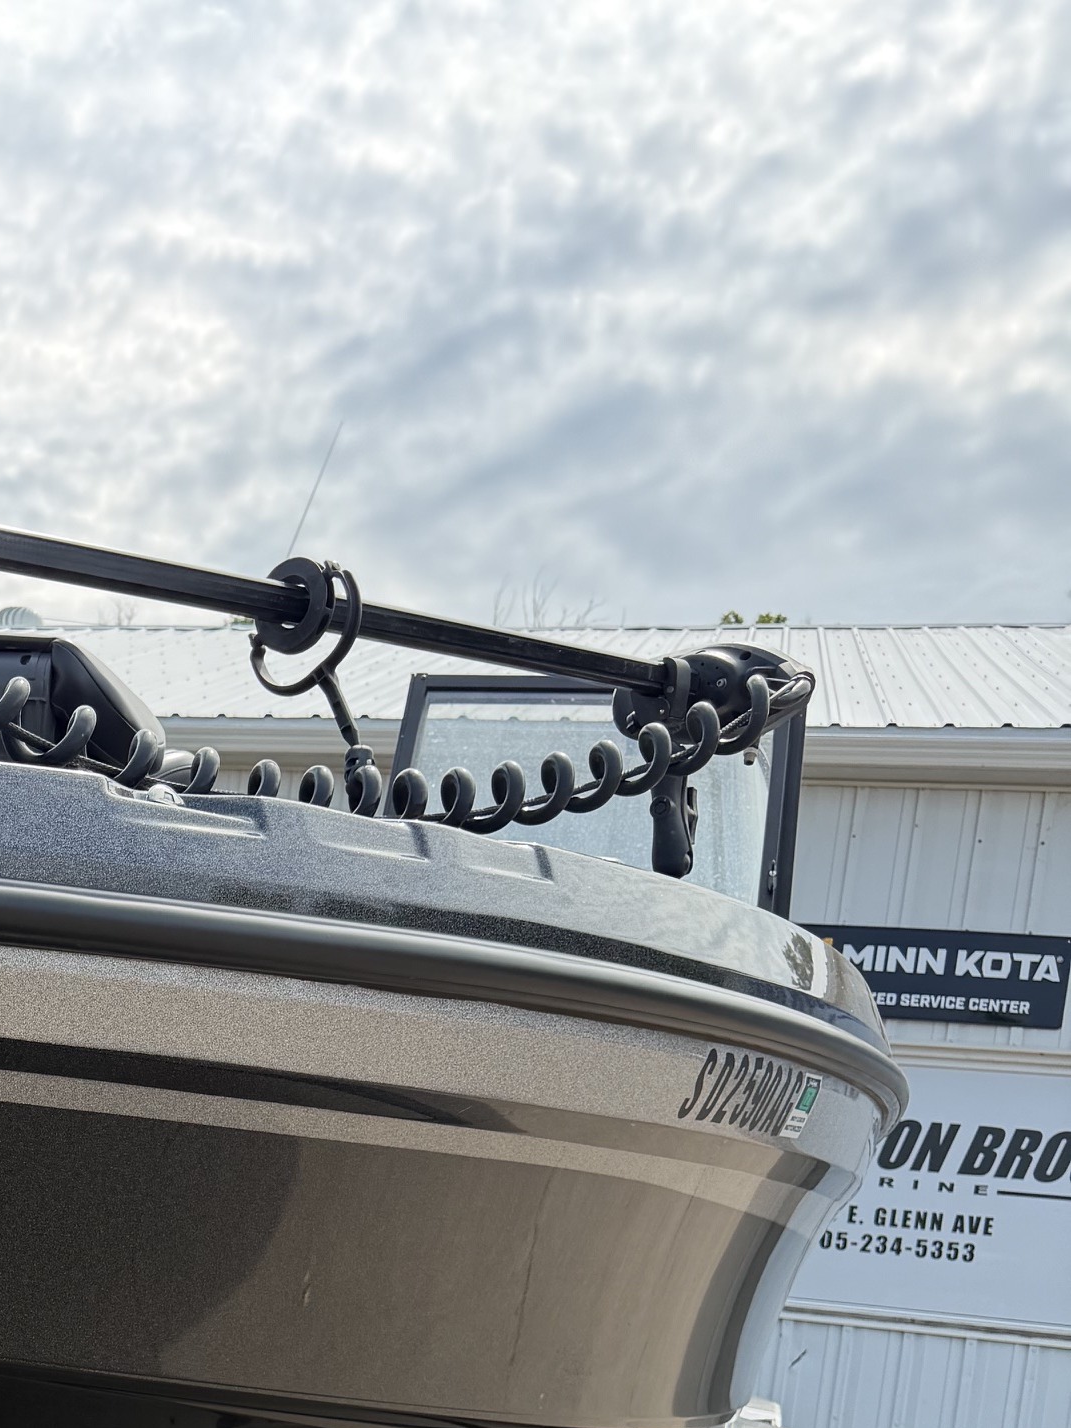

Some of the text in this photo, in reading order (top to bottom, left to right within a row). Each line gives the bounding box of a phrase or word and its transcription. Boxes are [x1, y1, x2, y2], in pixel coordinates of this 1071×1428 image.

[843, 943, 1060, 983] MINN KOTA
[899, 992, 965, 1011] SERVICE
[968, 997, 1031, 1015] CENTER
[957, 1125, 1071, 1183] BRO
[847, 1205, 995, 1236] E. GLENN AVE
[819, 1230, 976, 1263] 05-234-5353
